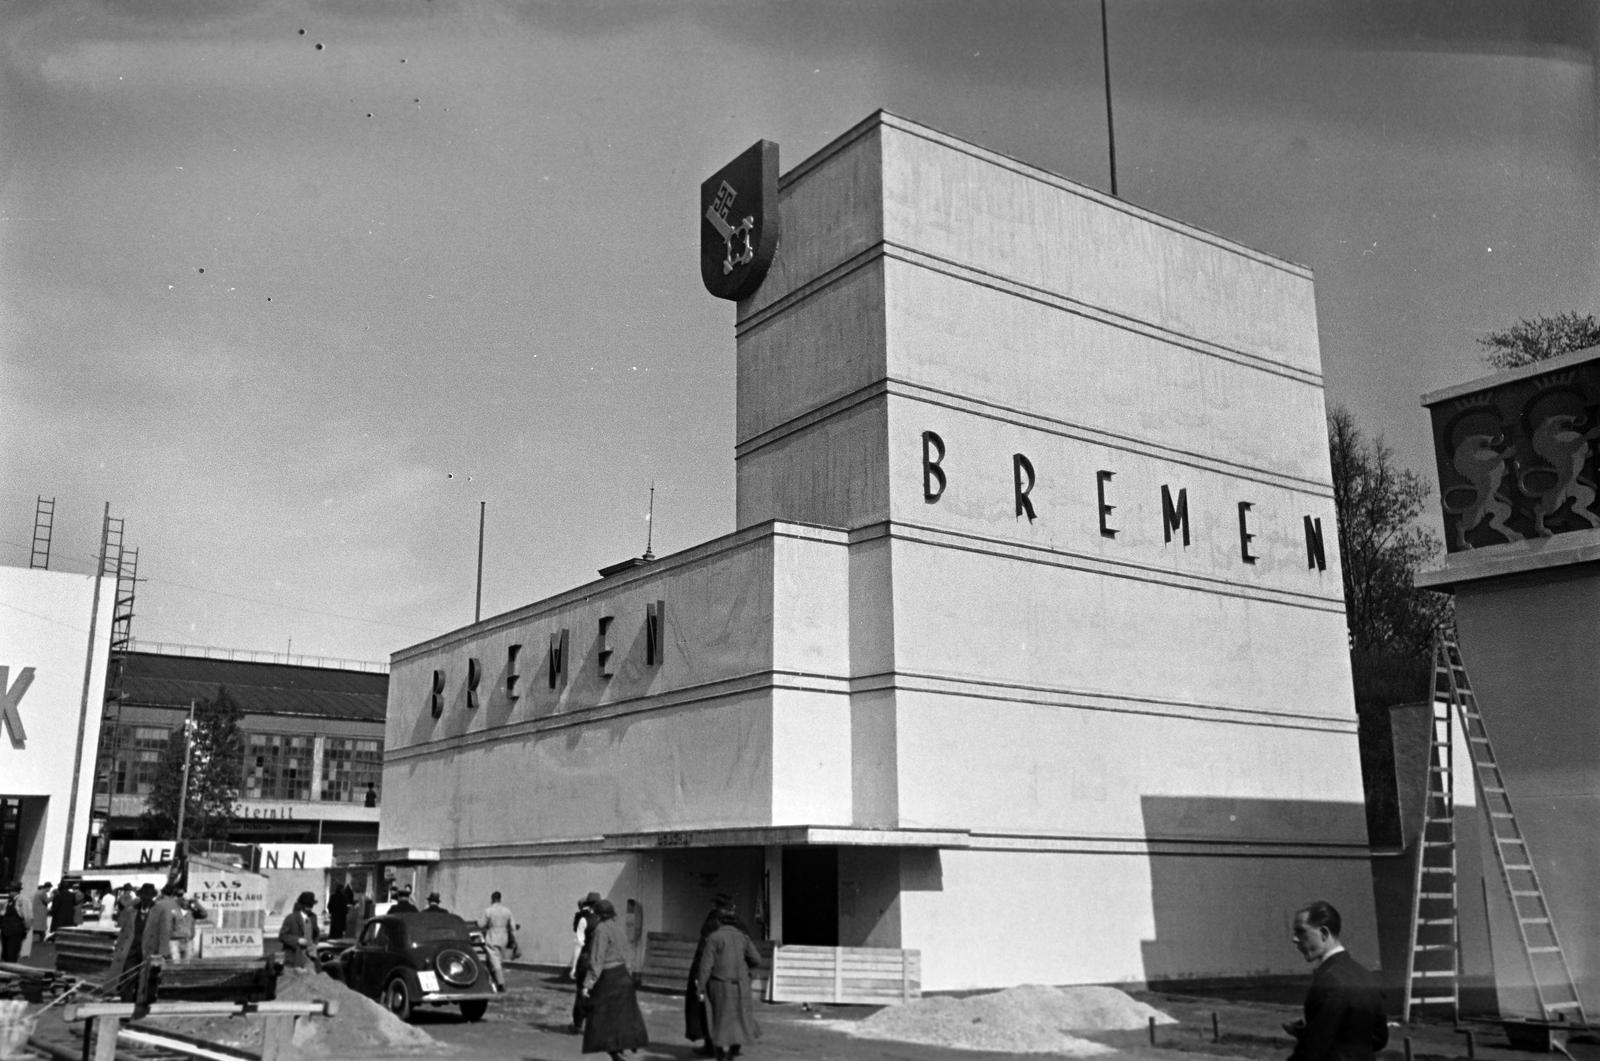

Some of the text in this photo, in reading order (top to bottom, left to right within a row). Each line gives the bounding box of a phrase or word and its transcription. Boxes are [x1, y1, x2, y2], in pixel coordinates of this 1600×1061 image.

[922, 430, 1326, 572] BREMEN
[431, 600, 665, 719] BREMEN
[204, 879, 242, 890] VAS
